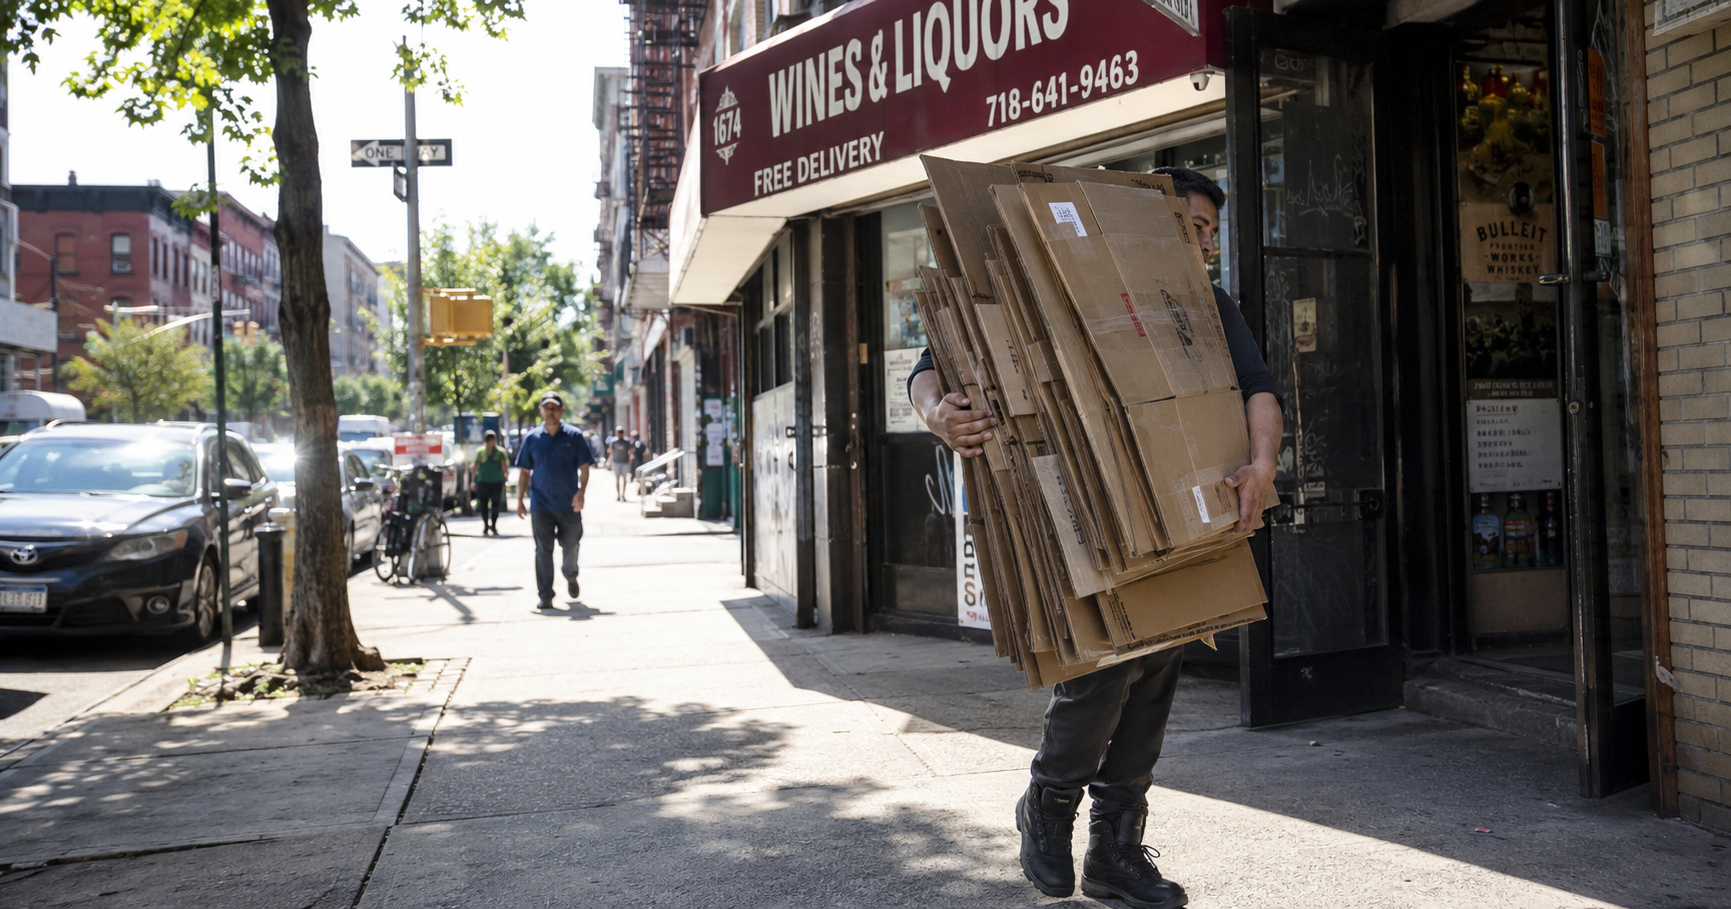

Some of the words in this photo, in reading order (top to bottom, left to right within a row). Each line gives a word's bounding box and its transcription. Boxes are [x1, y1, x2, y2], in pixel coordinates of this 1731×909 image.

[768, 38, 863, 138] WINES
[868, 29, 888, 103] &
[985, 50, 1139, 127] 718-641-9463
[712, 107, 742, 146] 1674
[365, 147, 394, 159] ONE
[754, 160, 792, 197] FREE
[797, 131, 884, 184] DELIVERY
[1476, 221, 1547, 242] BULLEIT
[1487, 264, 1540, 275] WHISKEY
